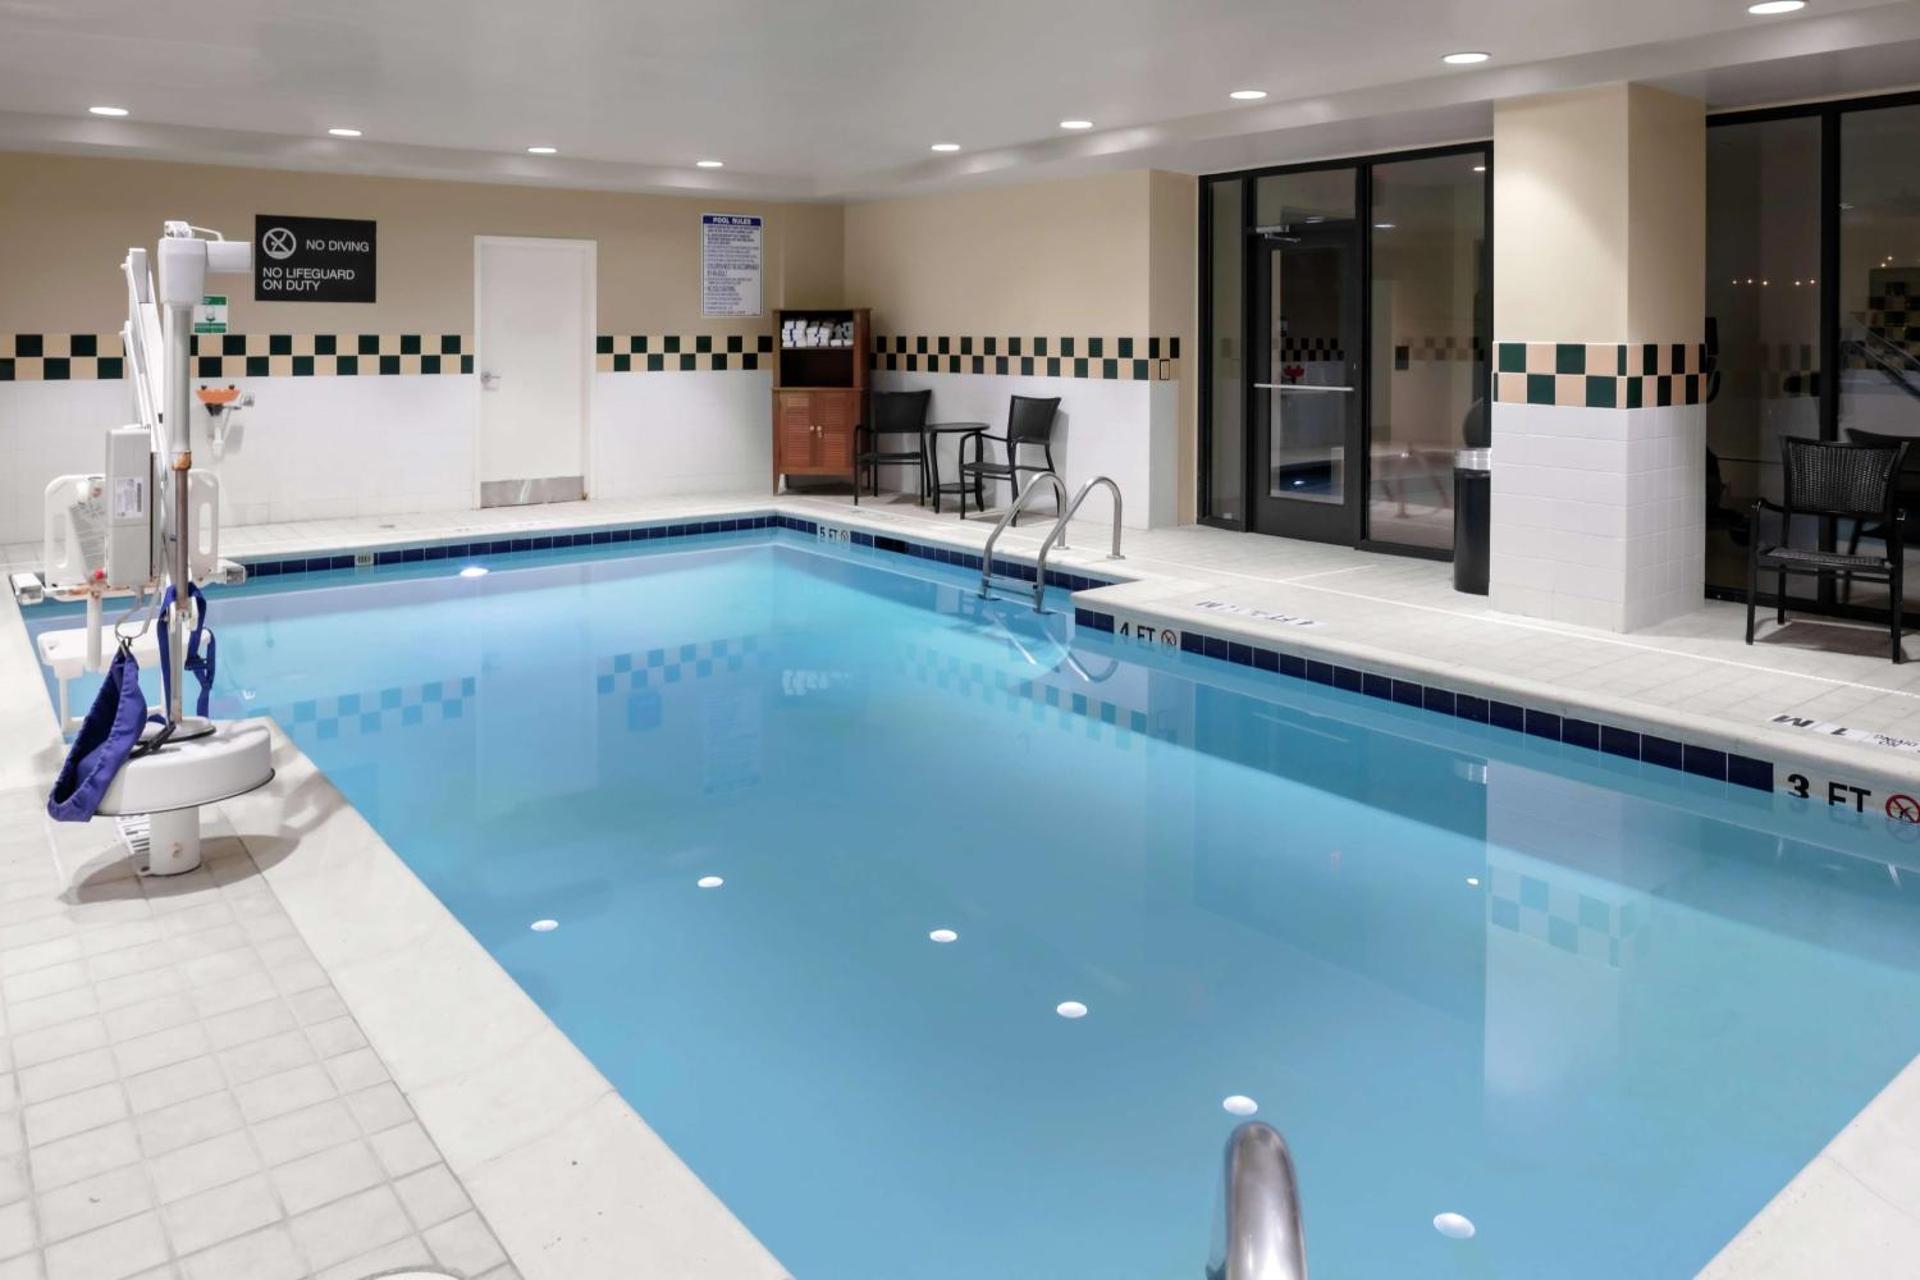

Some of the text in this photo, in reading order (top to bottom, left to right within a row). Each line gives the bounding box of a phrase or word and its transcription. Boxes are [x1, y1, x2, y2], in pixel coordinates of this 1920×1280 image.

[306, 239, 369, 252] NO DIVING
[263, 266, 355, 280] NO LIFEGUARD
[263, 279, 320, 291] ON DUTY
[1120, 621, 1156, 642] 4 FT
[1787, 773, 1872, 813] 3 FT
